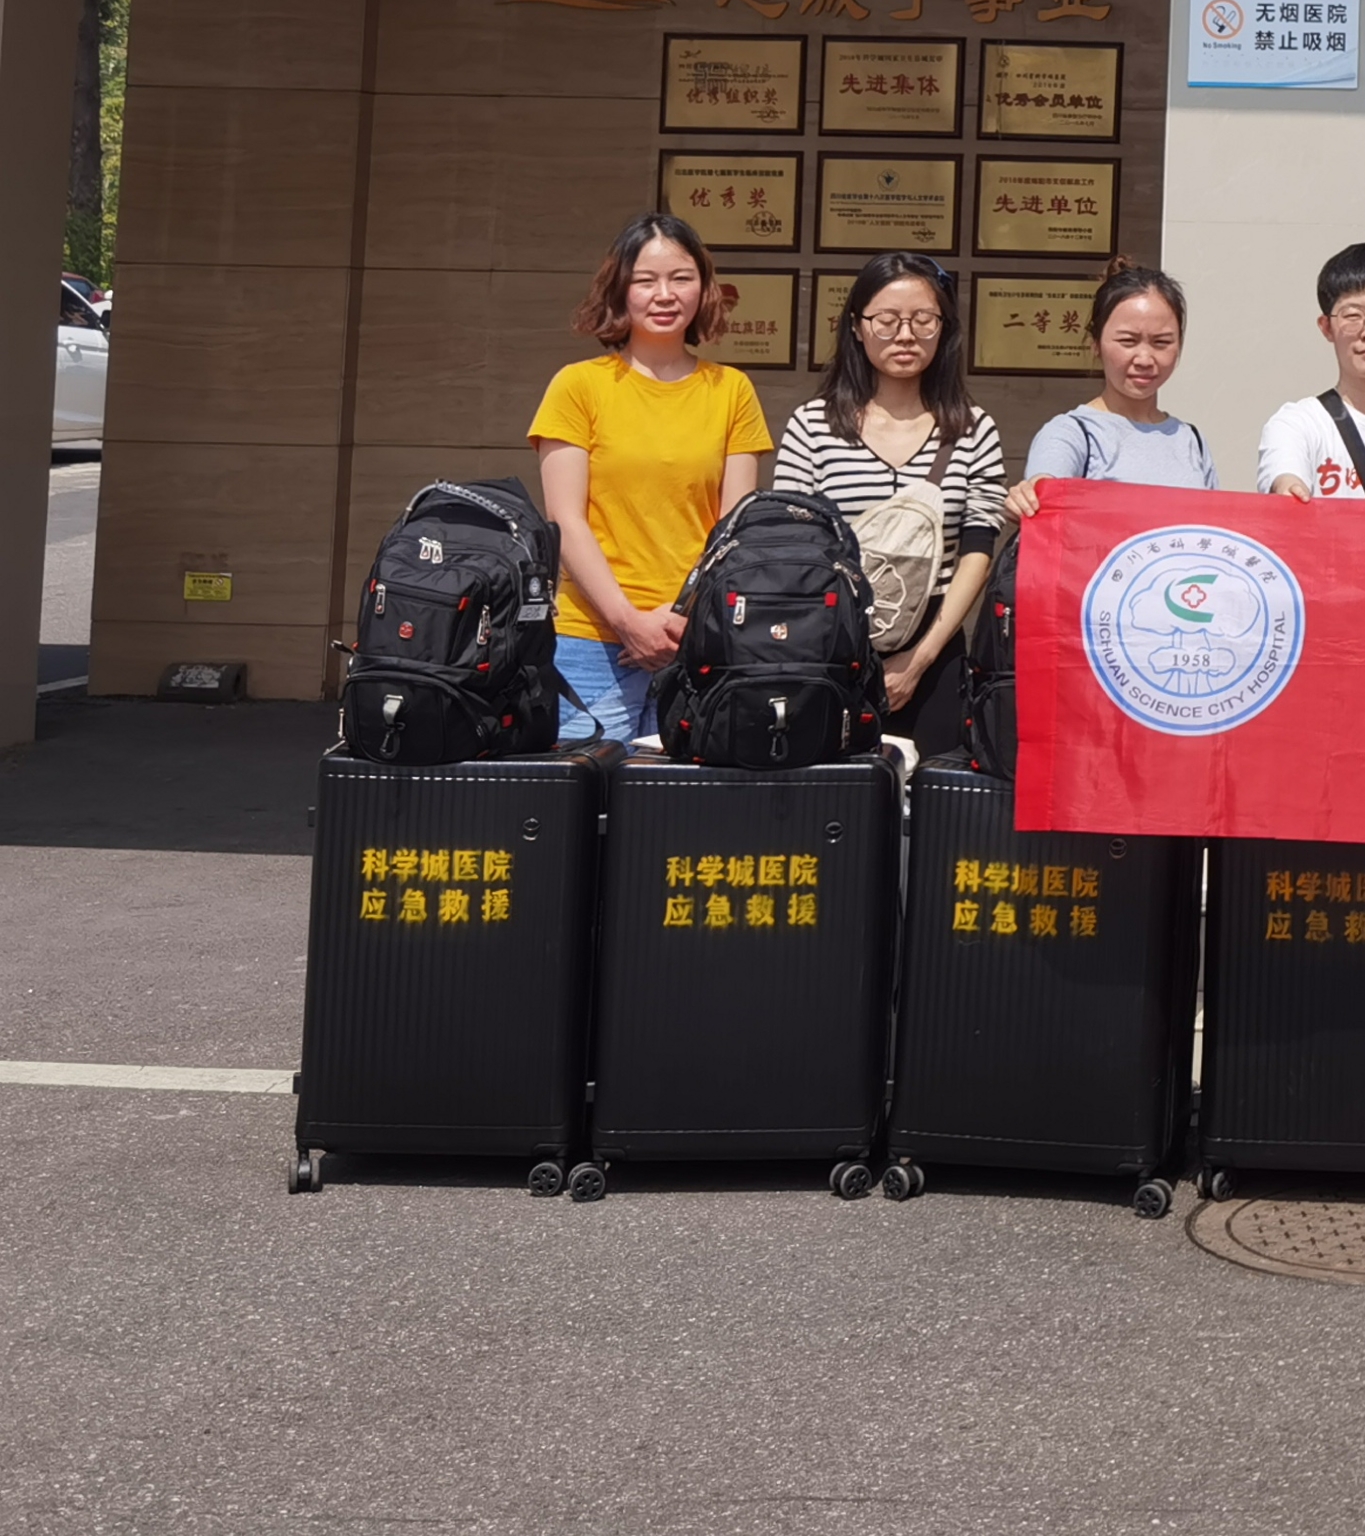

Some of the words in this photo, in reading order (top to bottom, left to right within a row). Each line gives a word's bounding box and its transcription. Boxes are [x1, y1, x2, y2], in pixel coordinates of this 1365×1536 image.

[1256, 3, 1348, 24] 无烟医院
[1213, 42, 1242, 50] Smoking
[1255, 31, 1347, 52] 禁止吸烟
[686, 87, 779, 106] 优秀组织奖
[838, 73, 941, 97] 先进集体
[995, 91, 1104, 110] 优秀会员单位
[689, 185, 768, 210] 优秀奖
[992, 193, 1099, 216] 先进单位
[1003, 309, 1082, 334] 二等奖
[1098, 609, 1130, 688] SICHUAN
[1128, 686, 1203, 719] SCIENCE
[1208, 690, 1246, 717] CITY
[1247, 610, 1286, 695] HOSPITAL
[1172, 653, 1211, 667] 1958
[361, 848, 513, 884] 科学城医院
[664, 854, 819, 889] 科学城医院
[953, 858, 1099, 898] 科学城医院
[360, 888, 512, 925] 应急救援
[662, 892, 819, 929] 应急救援
[951, 901, 1099, 936] 应急救援
